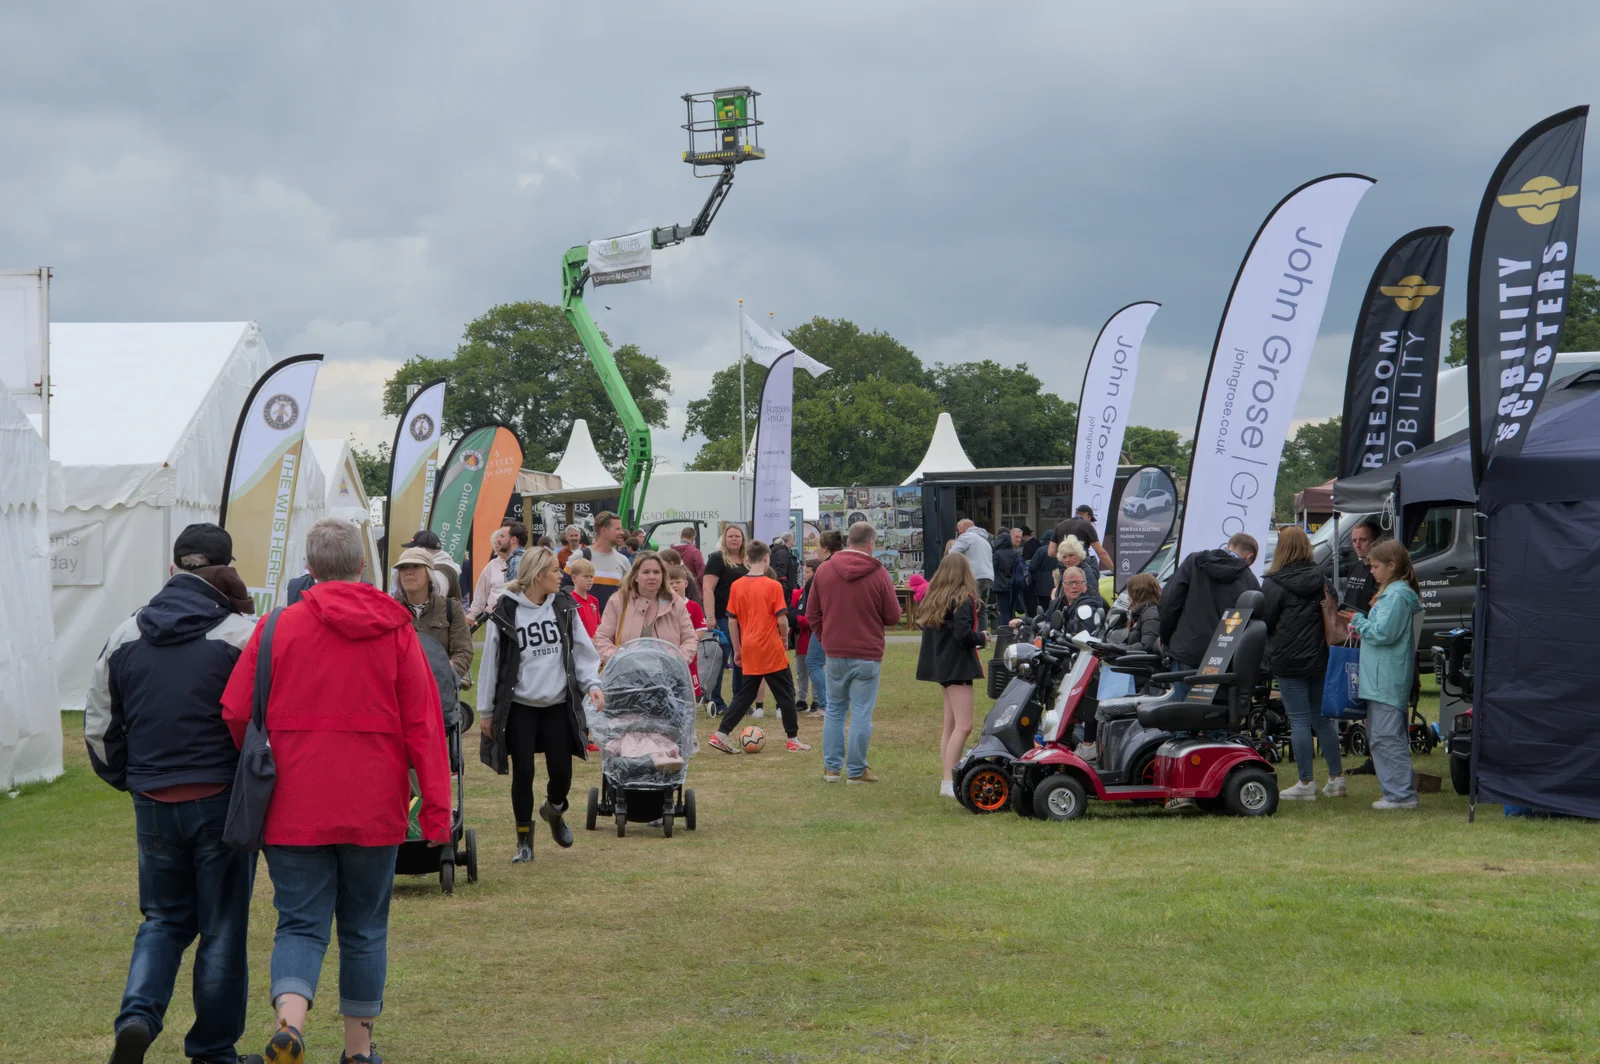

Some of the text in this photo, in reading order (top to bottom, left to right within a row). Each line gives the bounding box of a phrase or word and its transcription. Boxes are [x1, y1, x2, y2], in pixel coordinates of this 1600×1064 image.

[1271, 226, 1323, 322] John
[1106, 335, 1133, 397] John
[1497, 257, 1533, 443] OBILITY
[1215, 347, 1248, 456] johngrose.co.uk
[1240, 335, 1292, 449] Grose
[1362, 330, 1399, 468] REEDOM
[1394, 330, 1425, 459] OBILITY
[1083, 415, 1097, 485] johngrose.co.uk
[1095, 405, 1118, 478] Grose
[424, 491, 433, 508] WI
[426, 462, 436, 487] THE
[267, 457, 296, 586] THE WI IS HERE!
[455, 483, 473, 528] Outdoor
[641, 510, 720, 520] GADD BROTHERS
[49, 533, 80, 547] ents
[51, 555, 79, 573] day
[448, 533, 462, 560] Woo
[1426, 579, 1449, 587] Rental
[532, 646, 559, 657] STUDIO
[1208, 656, 1224, 665] SHOW
